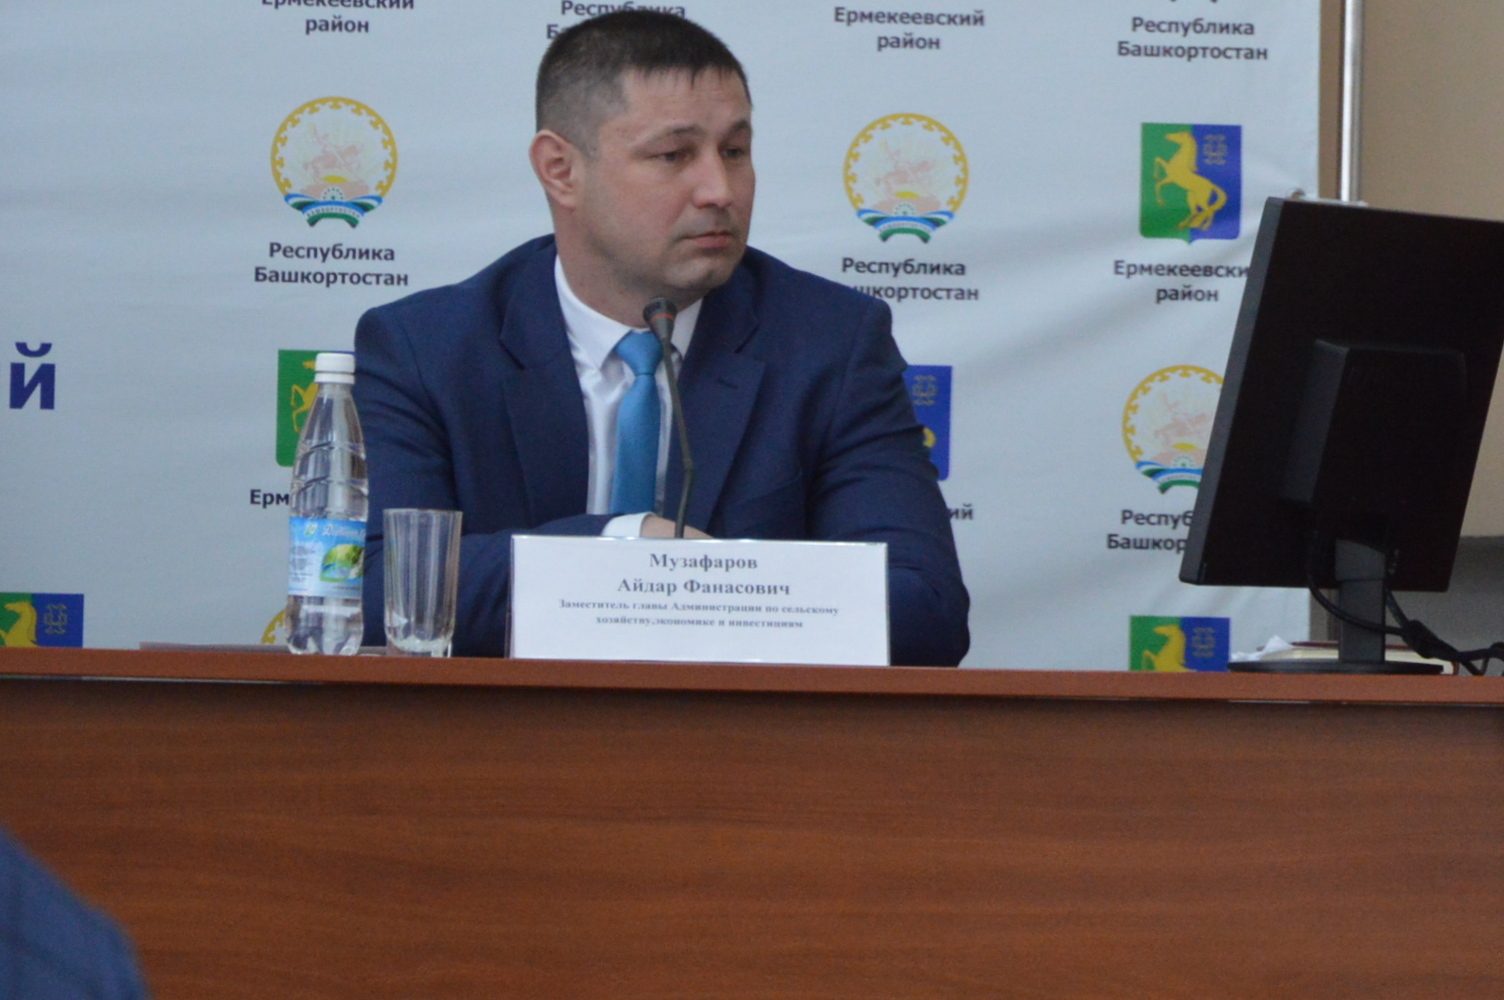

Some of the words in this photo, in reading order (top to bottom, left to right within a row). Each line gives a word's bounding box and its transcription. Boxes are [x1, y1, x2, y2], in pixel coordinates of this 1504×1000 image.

[305, 15, 370, 36] район
[834, 6, 985, 27] Ермекеевский
[1131, 16, 1255, 38] Республика
[877, 32, 941, 52] район
[1117, 40, 1268, 62] Башкортостан
[269, 241, 395, 263] Республика
[254, 266, 409, 288] Башкортостан
[841, 257, 967, 278] Республика
[1113, 259, 1250, 279] Ермекеевски
[1155, 284, 1219, 304] район
[1121, 509, 1195, 530] Респуб
[1106, 533, 1187, 554] Башкор
[649, 552, 759, 572] Музафаров
[617, 577, 677, 597] Айдар
[683, 579, 791, 596] Фанасович
[559, 598, 630, 611] Заместитель
